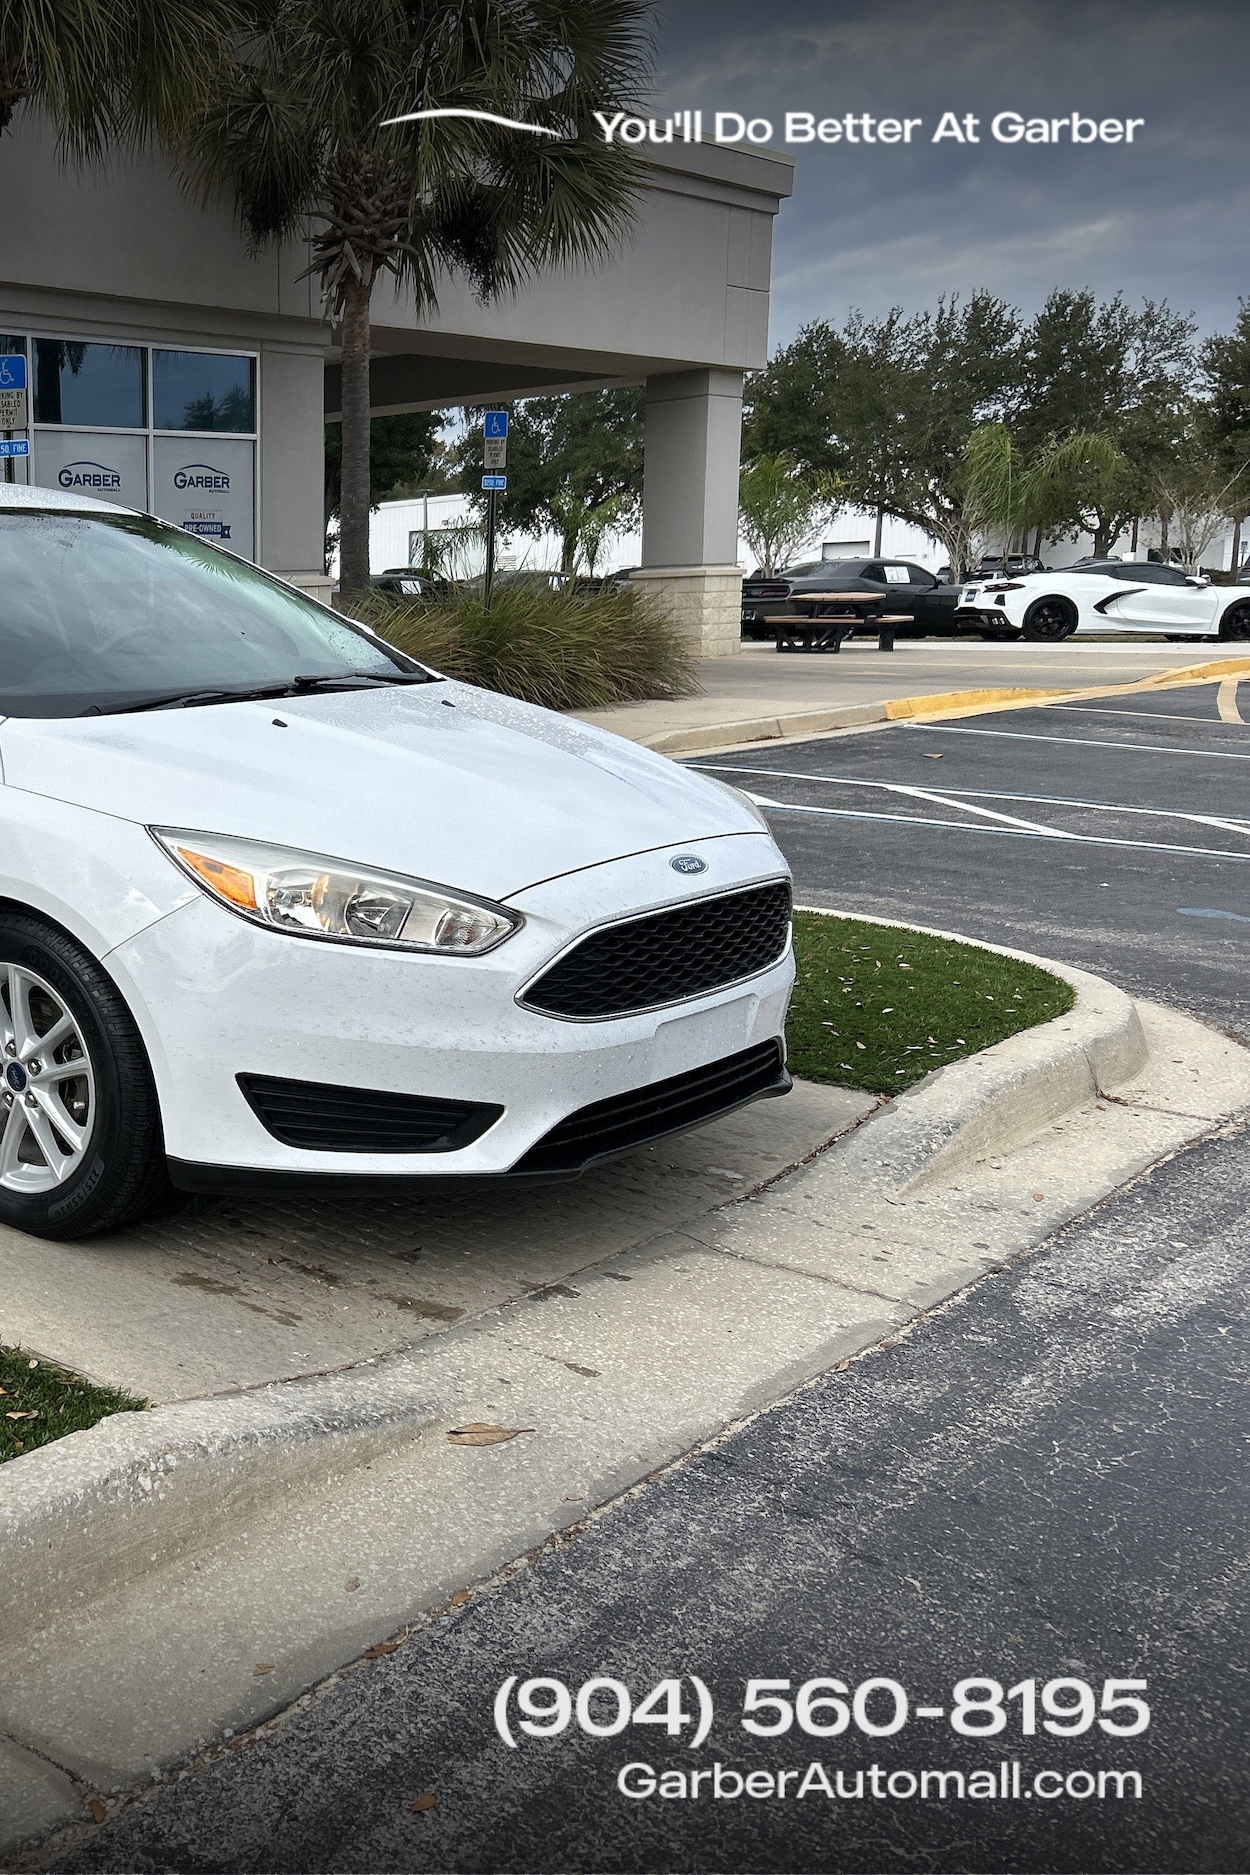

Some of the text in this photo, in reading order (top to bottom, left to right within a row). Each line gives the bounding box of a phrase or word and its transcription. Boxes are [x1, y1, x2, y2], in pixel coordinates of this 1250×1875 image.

[16, 391, 23, 399] BY
[0, 409, 17, 417] PERMIT
[2, 417, 15, 425] ONLY
[12, 443, 26, 452] FINE
[58, 469, 121, 488] GARBER
[173, 472, 230, 490] GARBER
[190, 512, 215, 520] QUALITY
[185, 523, 222, 533] PRE-OWNED
[679, 859, 701, 871] Ford
